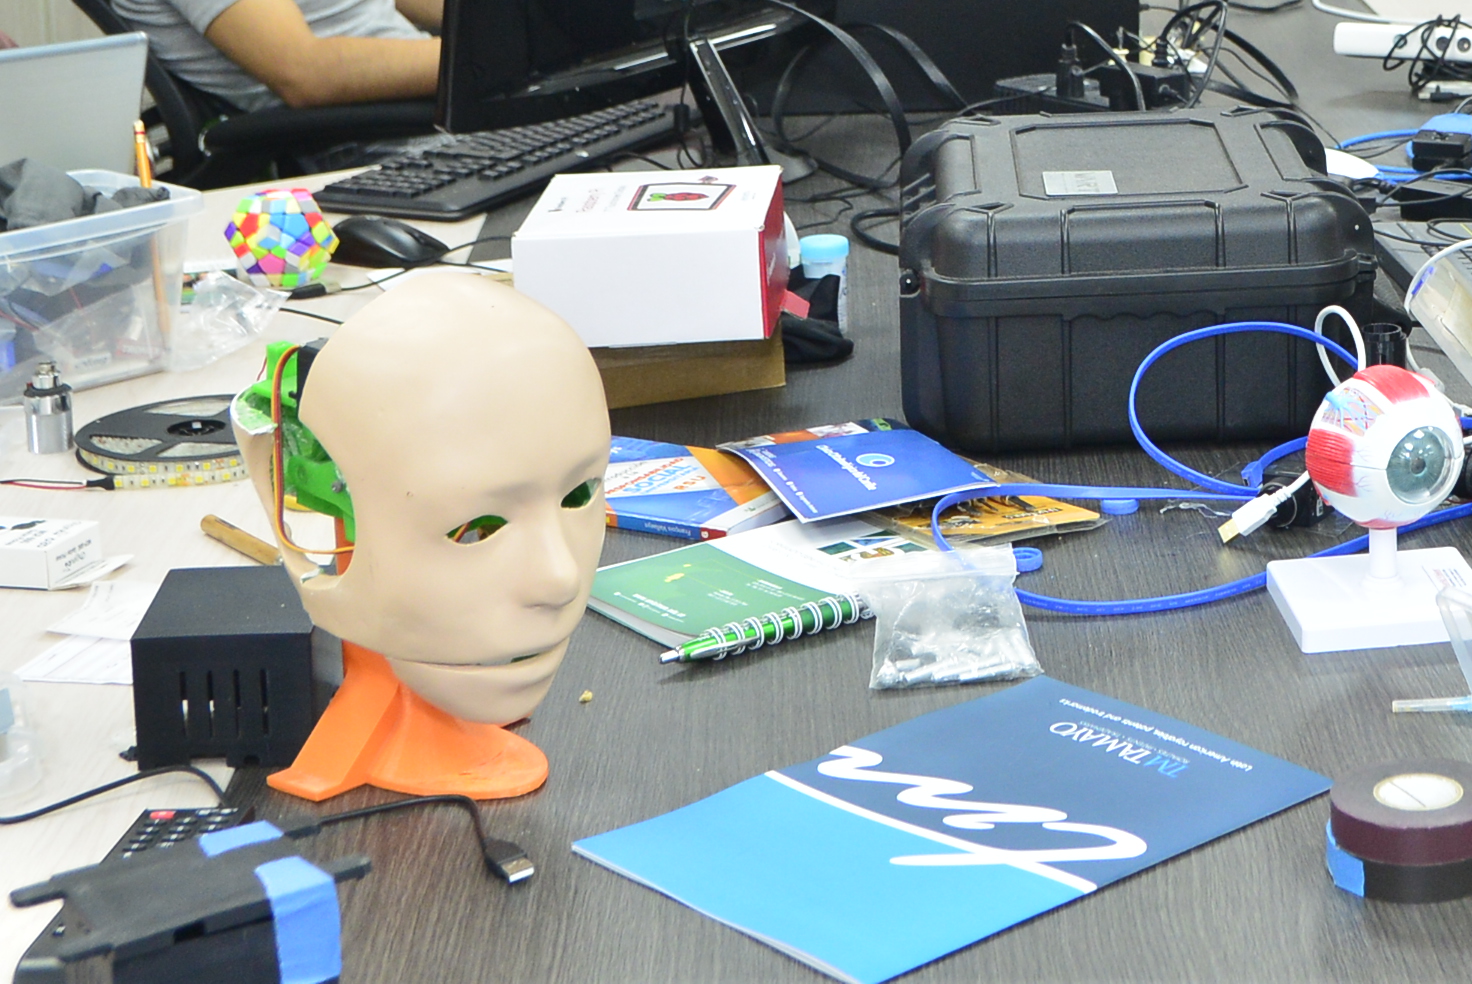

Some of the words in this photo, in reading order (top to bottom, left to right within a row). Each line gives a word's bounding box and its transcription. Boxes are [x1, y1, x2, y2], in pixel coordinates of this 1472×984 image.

[623, 465, 694, 494] SOCIAL
[1120, 718, 1155, 733] patents
[1049, 721, 1152, 764] TAMAYO
[1189, 743, 1231, 763] American
[1230, 759, 1253, 772] Latin
